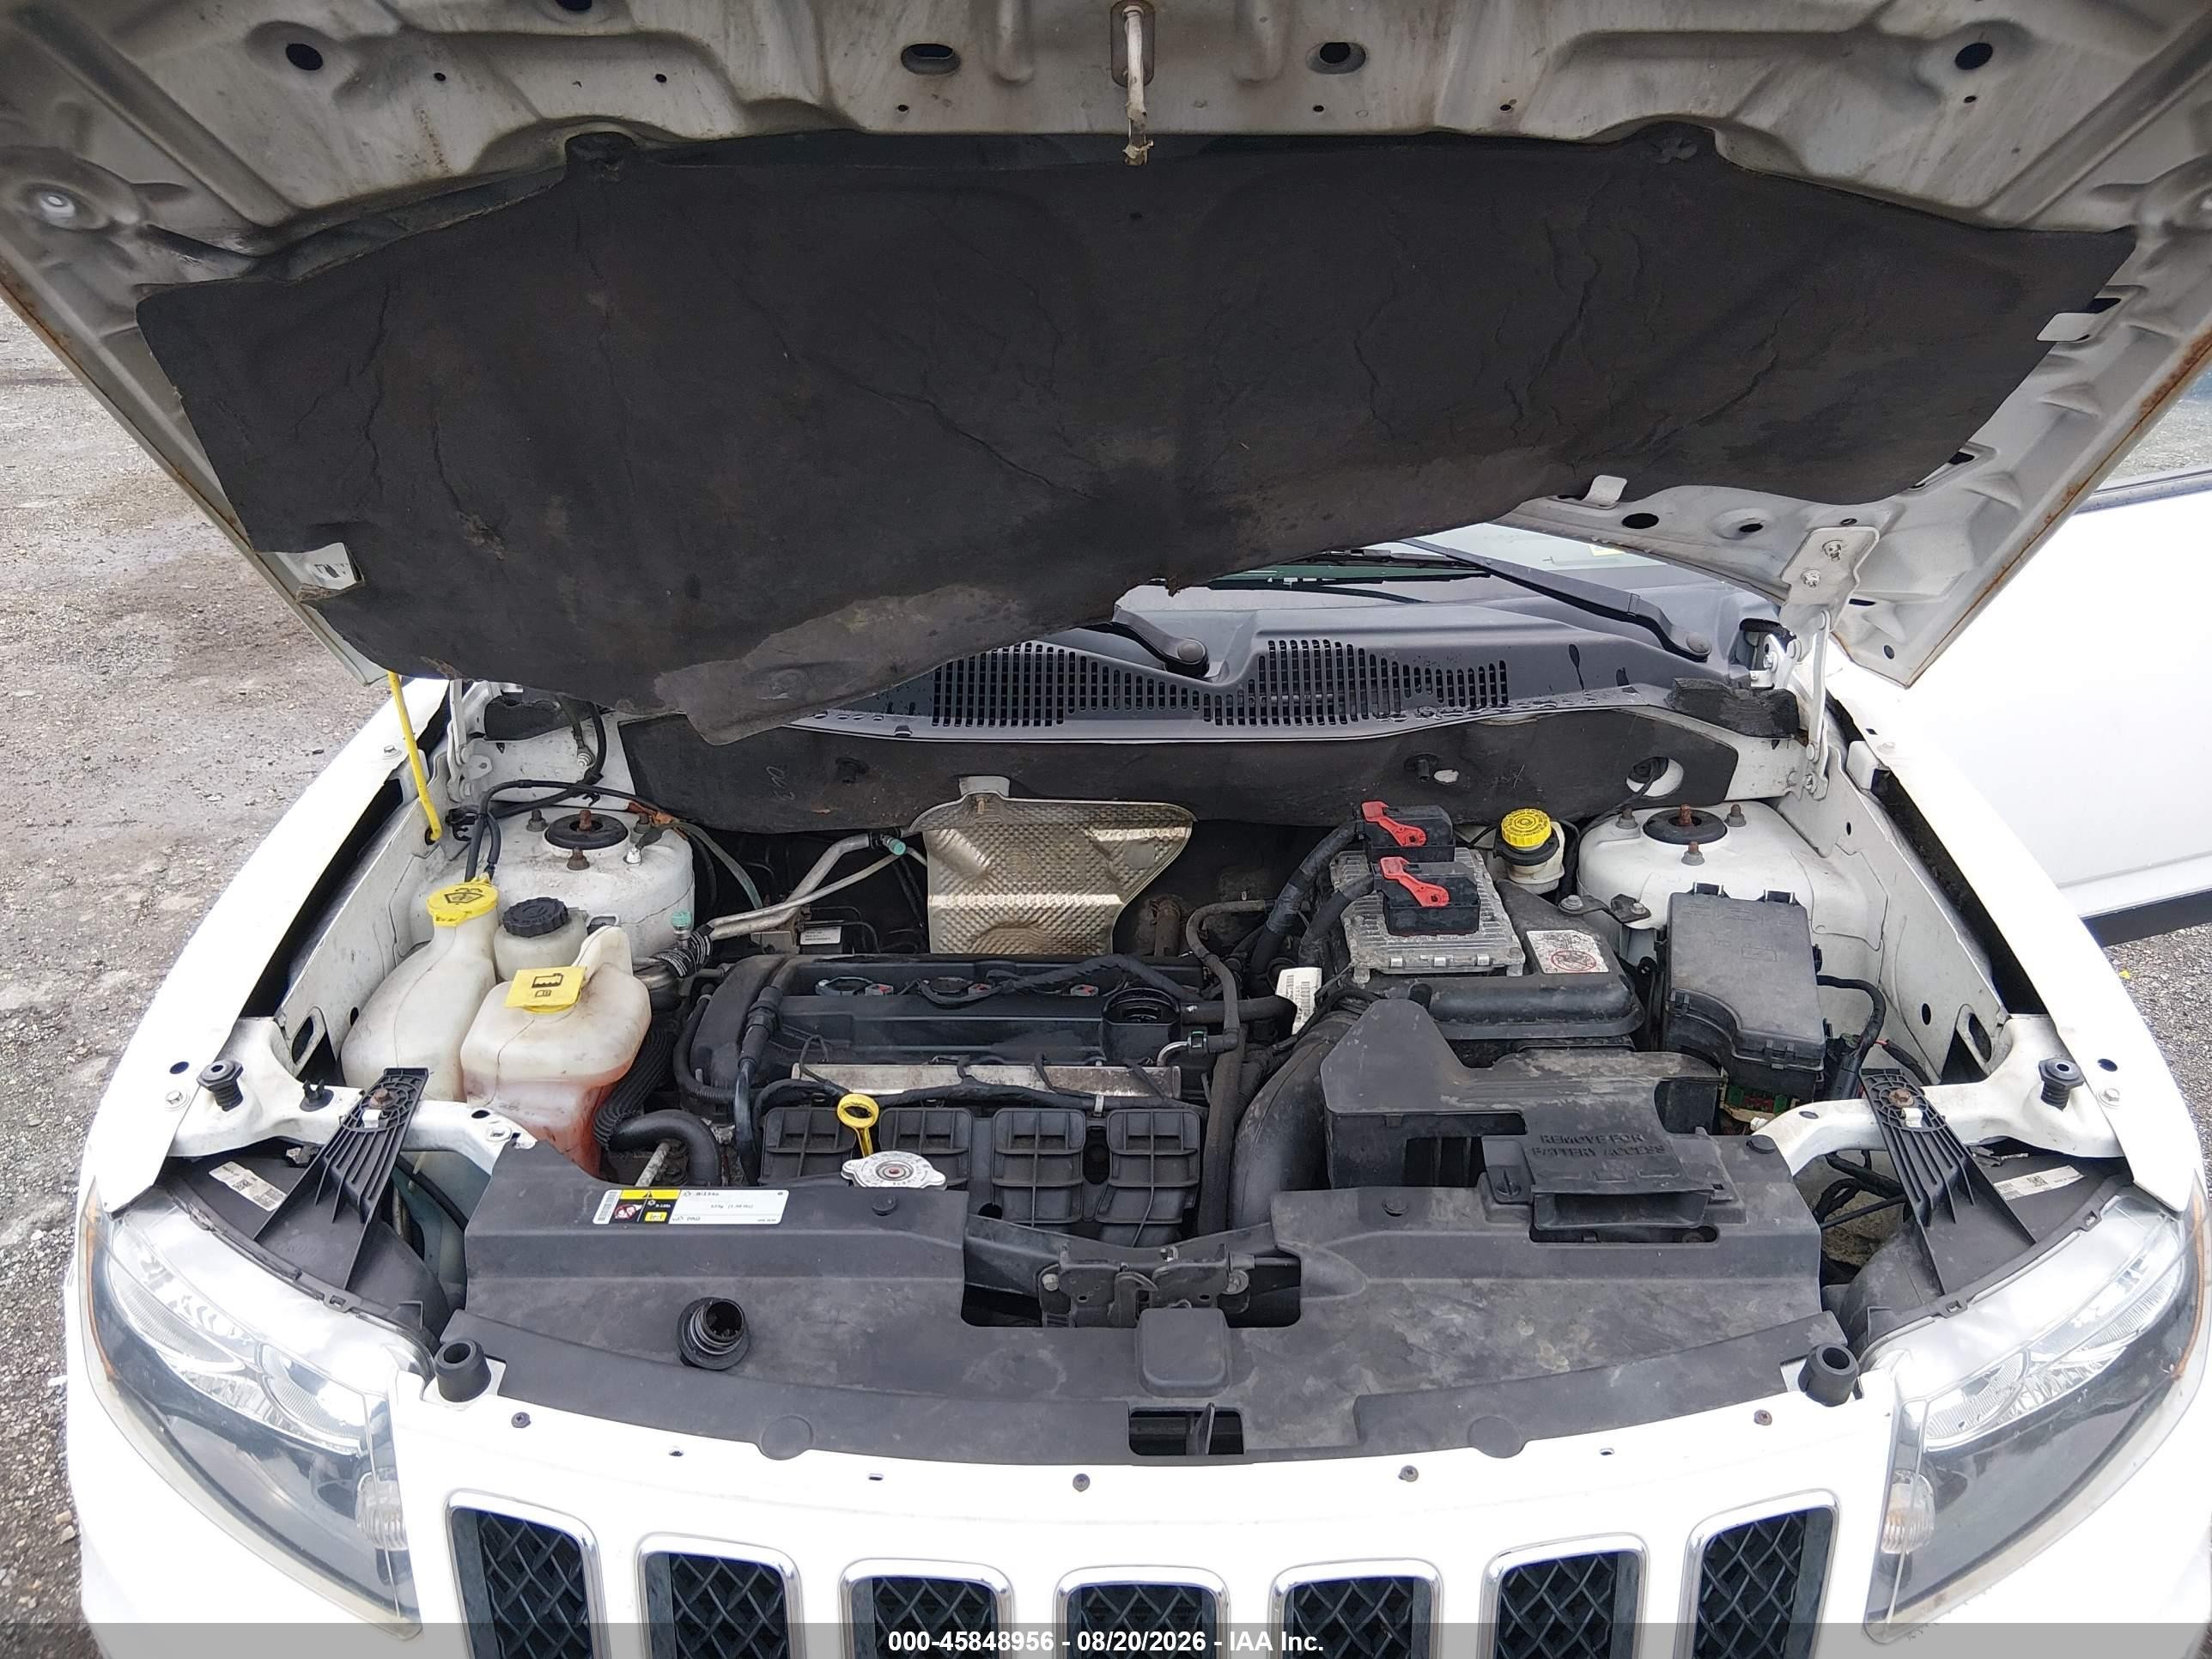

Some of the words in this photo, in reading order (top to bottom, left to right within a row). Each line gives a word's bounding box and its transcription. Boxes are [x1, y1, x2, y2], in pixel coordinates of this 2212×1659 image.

[1540, 1134, 1608, 1144] REMOVE
[1609, 1133, 1644, 1143] FOR
[1532, 1147, 1597, 1157] BATTERY
[1603, 1146, 1665, 1156] ACCESS
